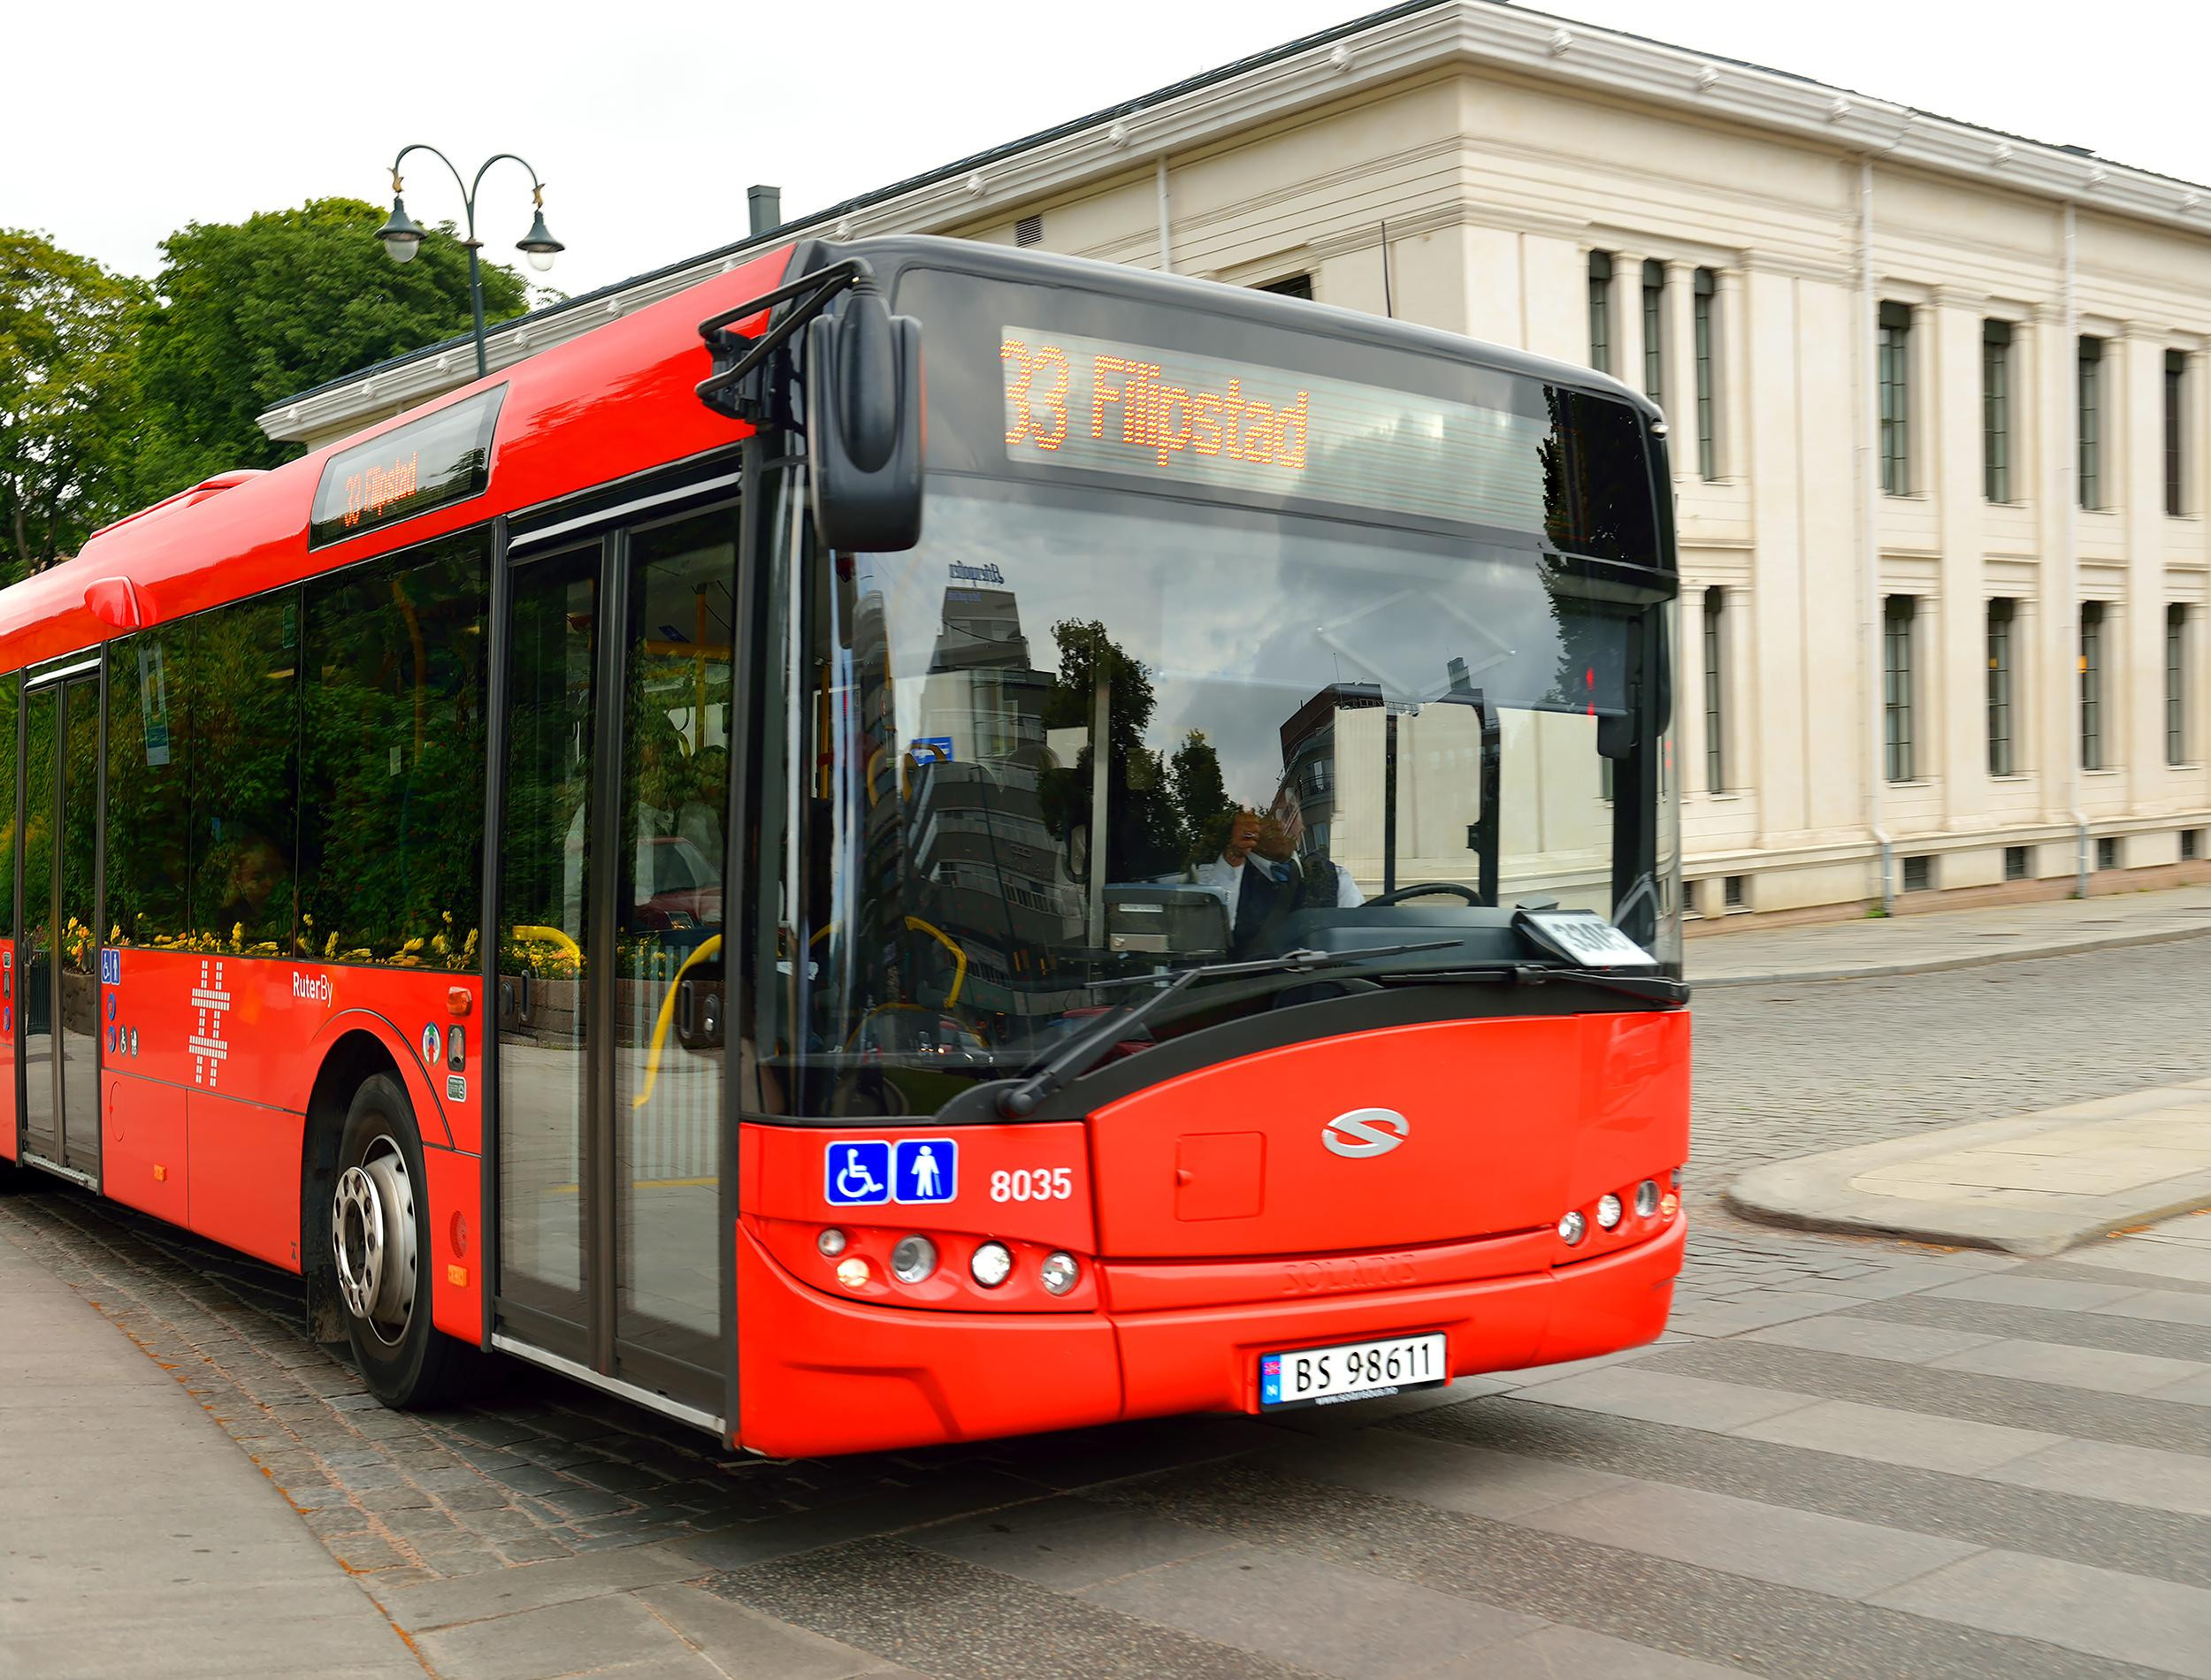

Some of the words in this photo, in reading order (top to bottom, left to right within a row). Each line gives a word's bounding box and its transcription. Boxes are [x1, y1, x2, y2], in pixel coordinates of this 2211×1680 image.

[1000, 339, 1068, 451] 33
[1090, 355, 1308, 469] Filipstad
[1550, 922, 1631, 952] 3305
[293, 971, 333, 1008] RuterBy
[990, 1168, 1073, 1203] 8035
[1296, 1355, 1331, 1394] BS
[1346, 1342, 1430, 1386] 98611
